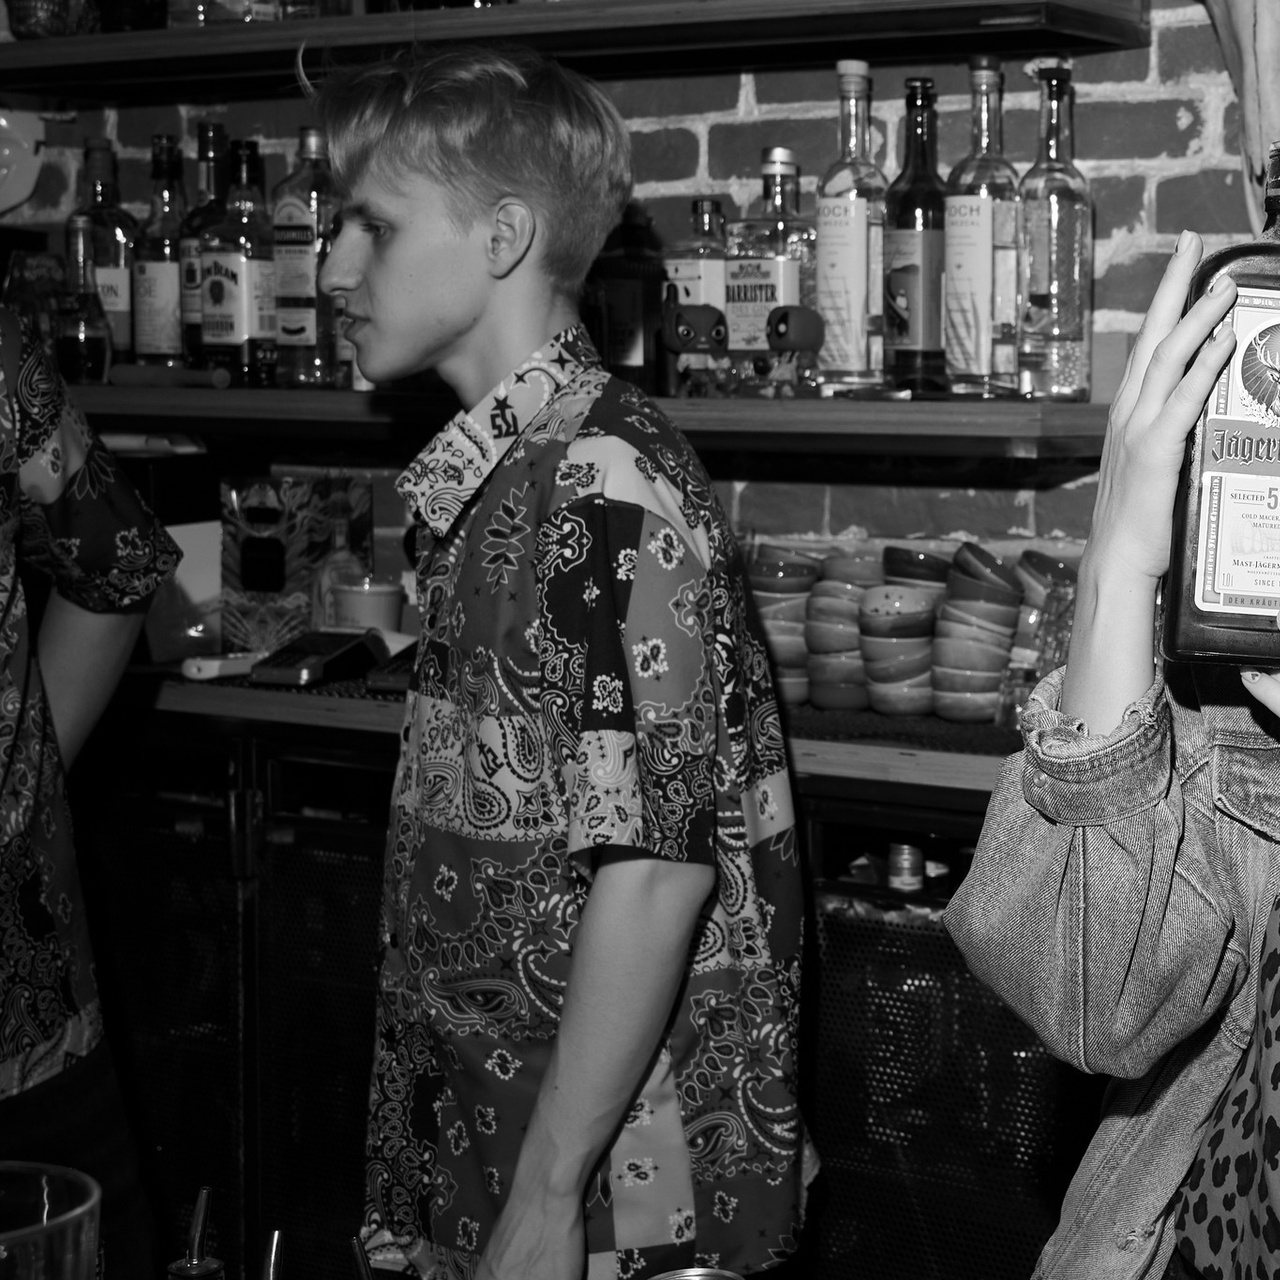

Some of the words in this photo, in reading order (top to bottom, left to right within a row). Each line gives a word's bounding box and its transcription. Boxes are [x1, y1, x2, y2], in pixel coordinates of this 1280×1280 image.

[1230, 493, 1265, 502] SELECTED
[1254, 578, 1275, 587] SINCE
[1228, 596, 1246, 605] DER
